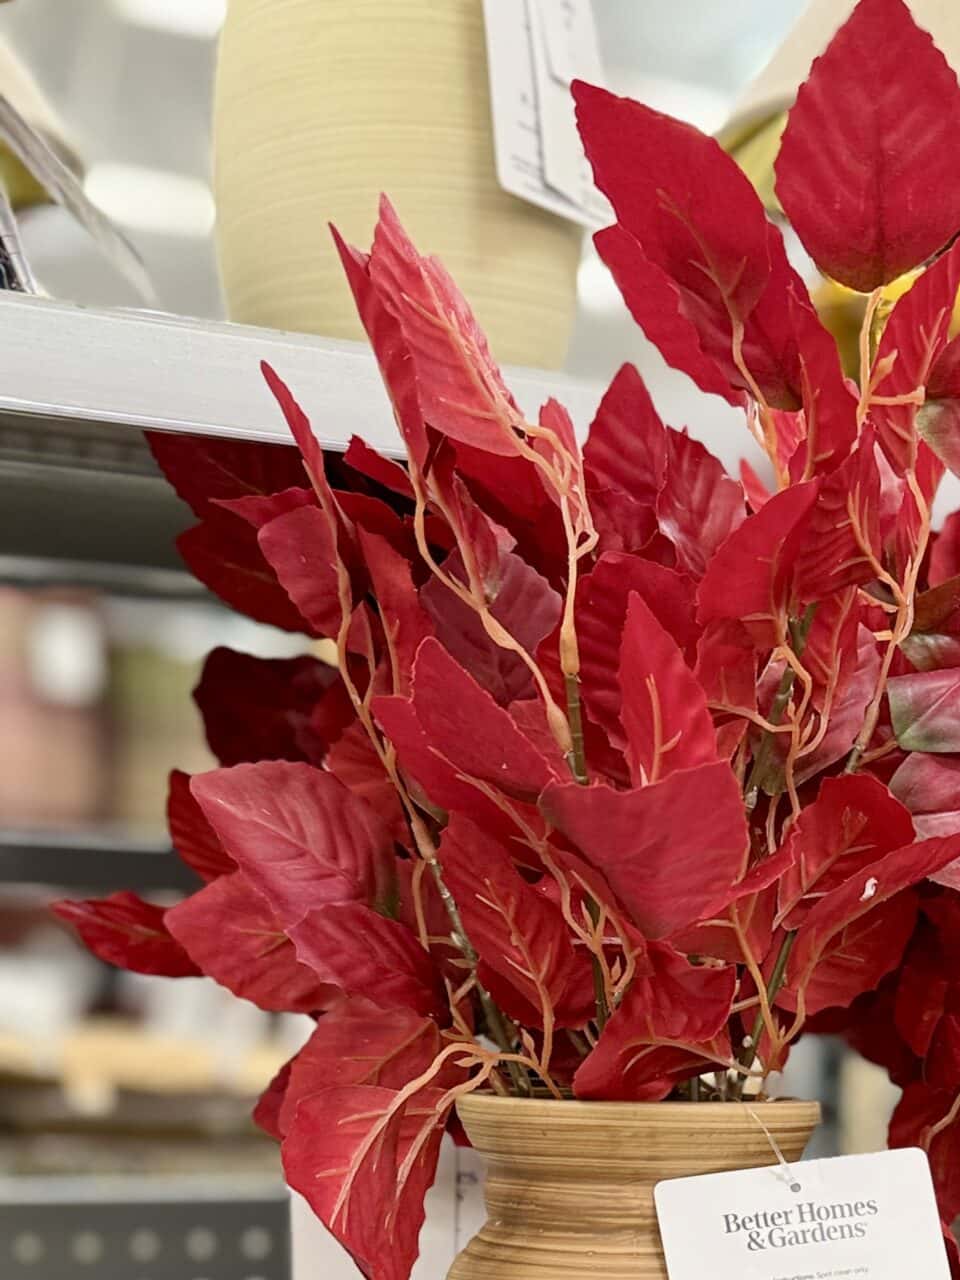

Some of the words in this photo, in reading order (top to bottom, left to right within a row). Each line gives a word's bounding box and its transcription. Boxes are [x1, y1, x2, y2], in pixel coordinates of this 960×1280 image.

[722, 1211, 793, 1234] Better
[797, 1200, 878, 1223] Homes
[768, 1221, 866, 1248] Gardens
